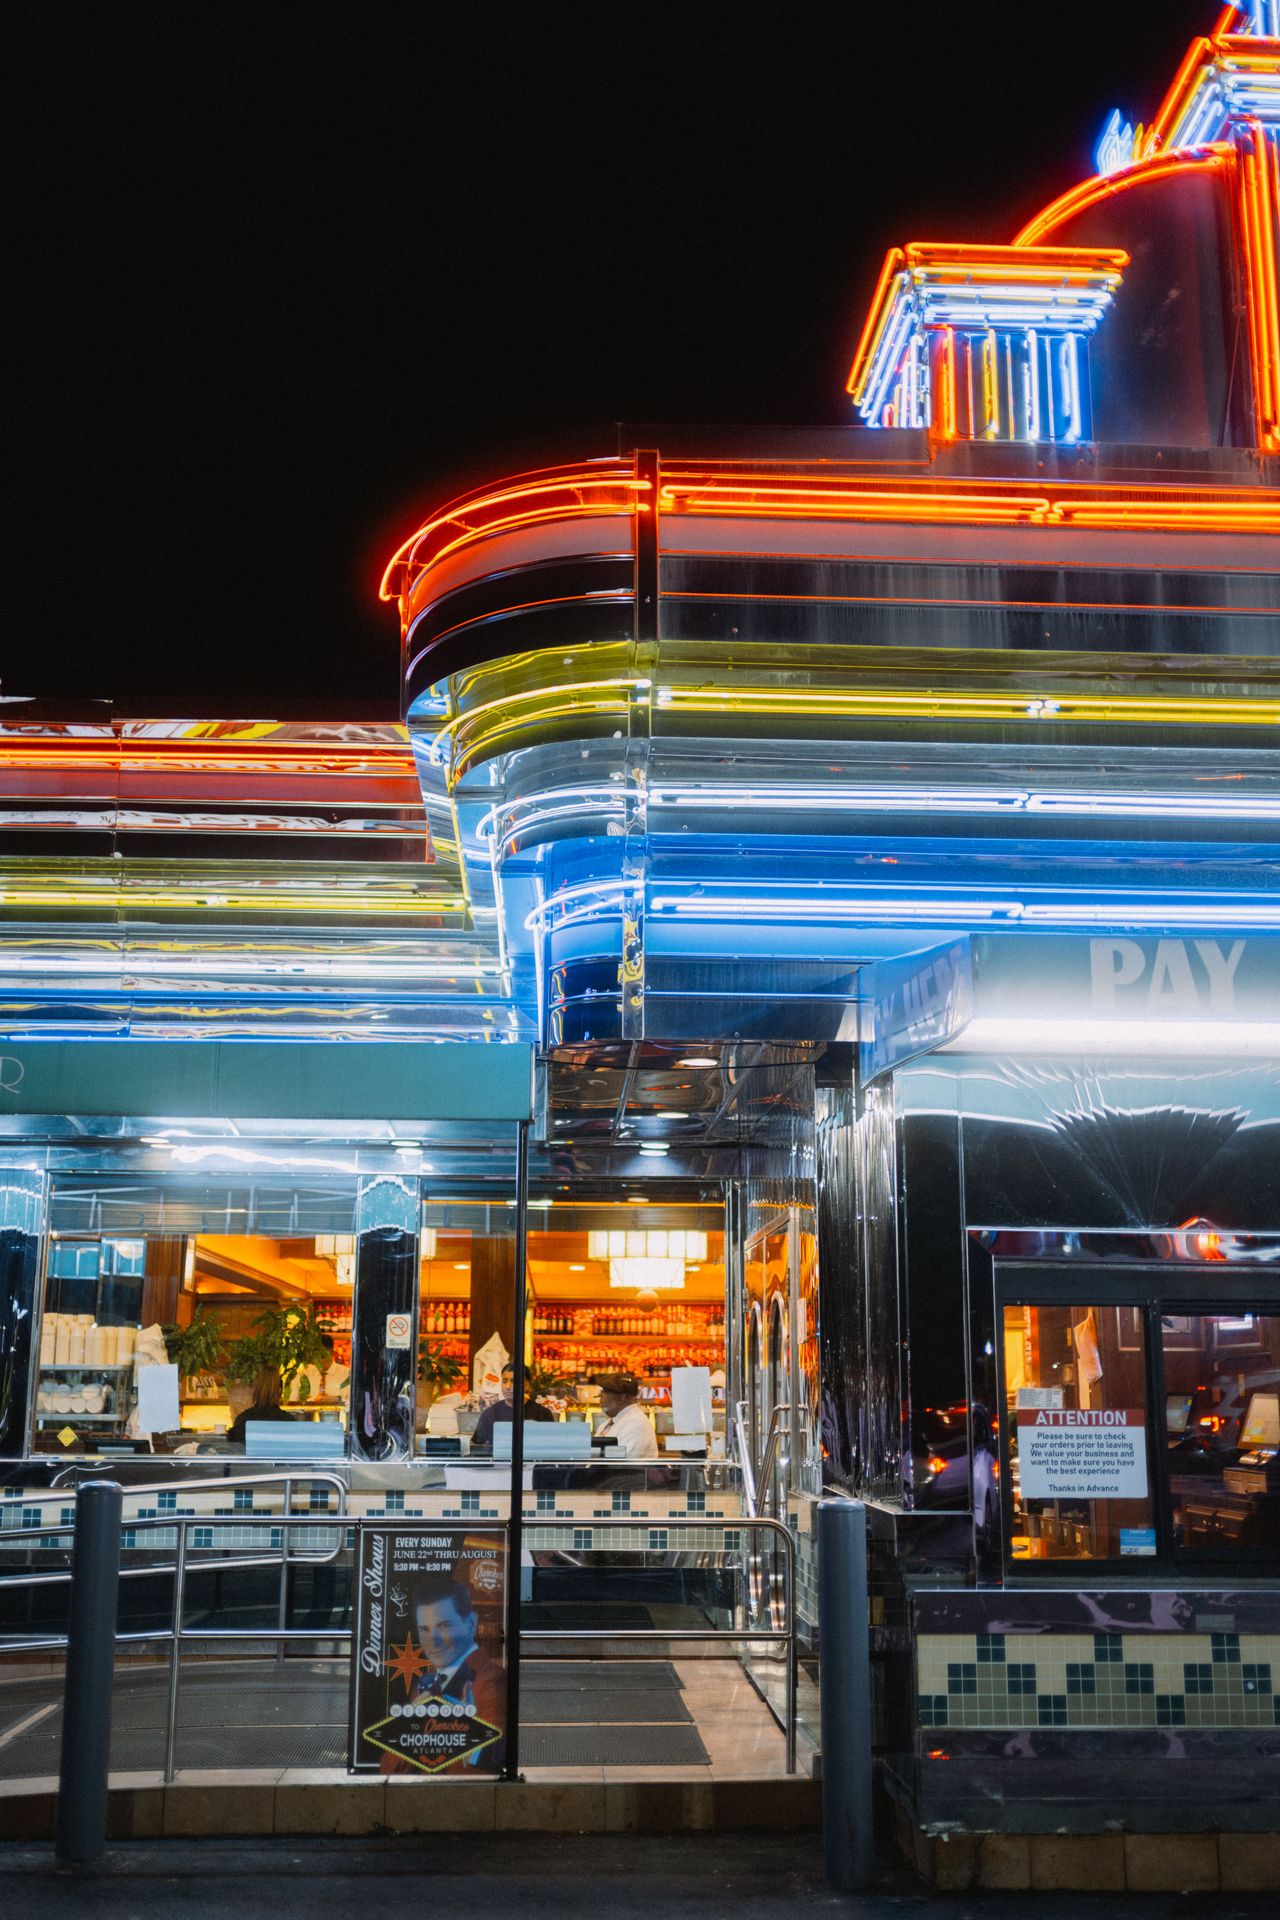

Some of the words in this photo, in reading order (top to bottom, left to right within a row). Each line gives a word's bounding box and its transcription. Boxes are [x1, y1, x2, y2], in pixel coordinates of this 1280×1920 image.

[1089, 938, 1247, 1012] PAY
[1035, 1410, 1127, 1425] ATTENTION
[1037, 1432, 1062, 1440] Please
[1065, 1432, 1074, 1440] be
[1104, 1432, 1126, 1440] check
[1031, 1443, 1048, 1451] your
[1049, 1441, 1075, 1449] orders
[1076, 1441, 1095, 1451] prior
[1106, 1441, 1133, 1451] leaving
[1030, 1449, 1042, 1457] We
[1044, 1449, 1065, 1457] value
[1066, 1451, 1082, 1459] your
[1084, 1449, 1119, 1457] business
[1120, 1449, 1134, 1457] and
[1060, 1458, 1081, 1466] make
[1102, 1460, 1115, 1468] you
[1117, 1458, 1135, 1466] have
[1046, 1467, 1058, 1475] the
[1060, 1467, 1077, 1475] best
[1078, 1467, 1120, 1476] experience
[1048, 1484, 1076, 1492] Thanks
[1078, 1484, 1085, 1492] in
[1086, 1484, 1119, 1492] Advance
[395, 1537, 419, 1548] EVERY
[420, 1537, 453, 1547] SUNDAY
[393, 1550, 416, 1559] JUNE
[434, 1550, 459, 1559] THRU
[461, 1550, 498, 1559] AUGUST
[363, 1534, 384, 1598] Shows
[394, 1563, 408, 1571] 5:30
[409, 1563, 419, 1571] PM
[441, 1563, 451, 1571] PM
[361, 1602, 382, 1677] Dinner
[392, 1705, 474, 1716] WELCOME
[411, 1723, 420, 1731] TO
[400, 1734, 466, 1746] CHOPHOUSE
